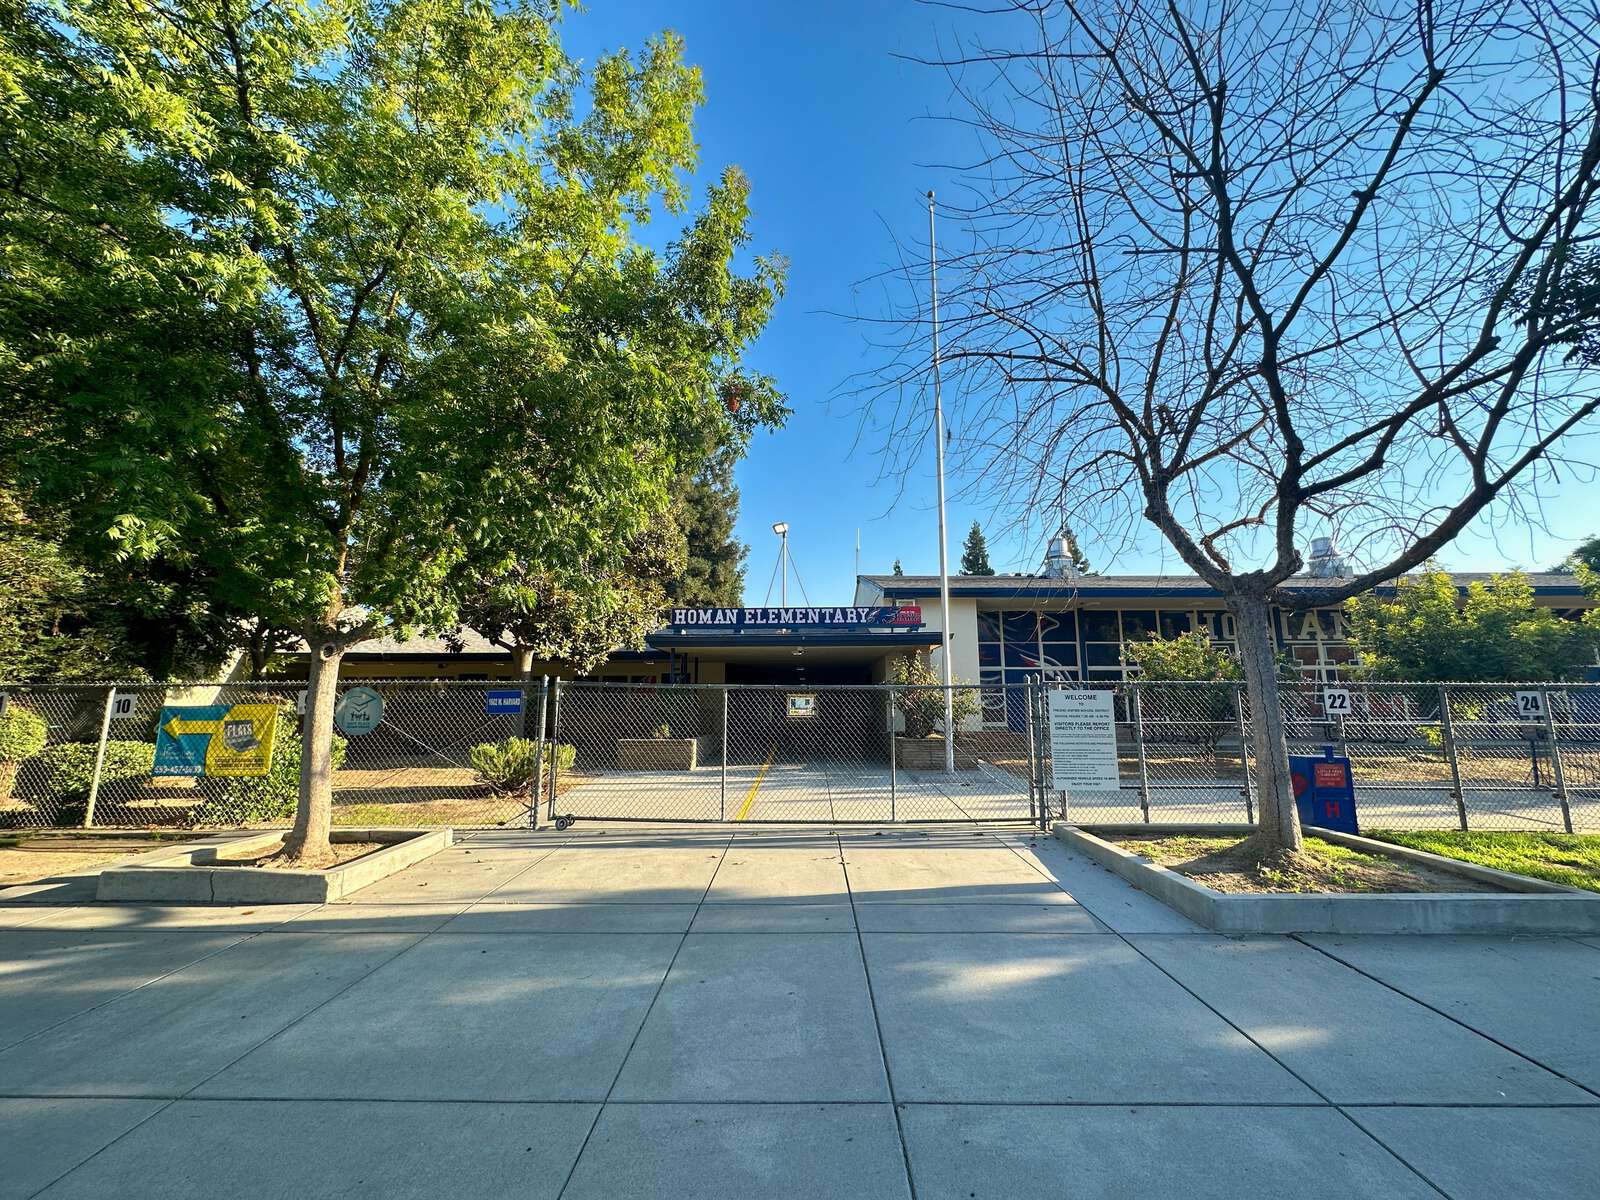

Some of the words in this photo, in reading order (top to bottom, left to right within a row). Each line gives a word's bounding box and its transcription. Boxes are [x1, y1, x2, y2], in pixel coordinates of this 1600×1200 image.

[674, 609, 738, 624] HOMAN
[744, 608, 869, 624] ELEMENTARY
[115, 699, 131, 714] 10
[1327, 693, 1347, 709] 22
[1521, 695, 1540, 711] 24
[1325, 800, 1340, 817] H
